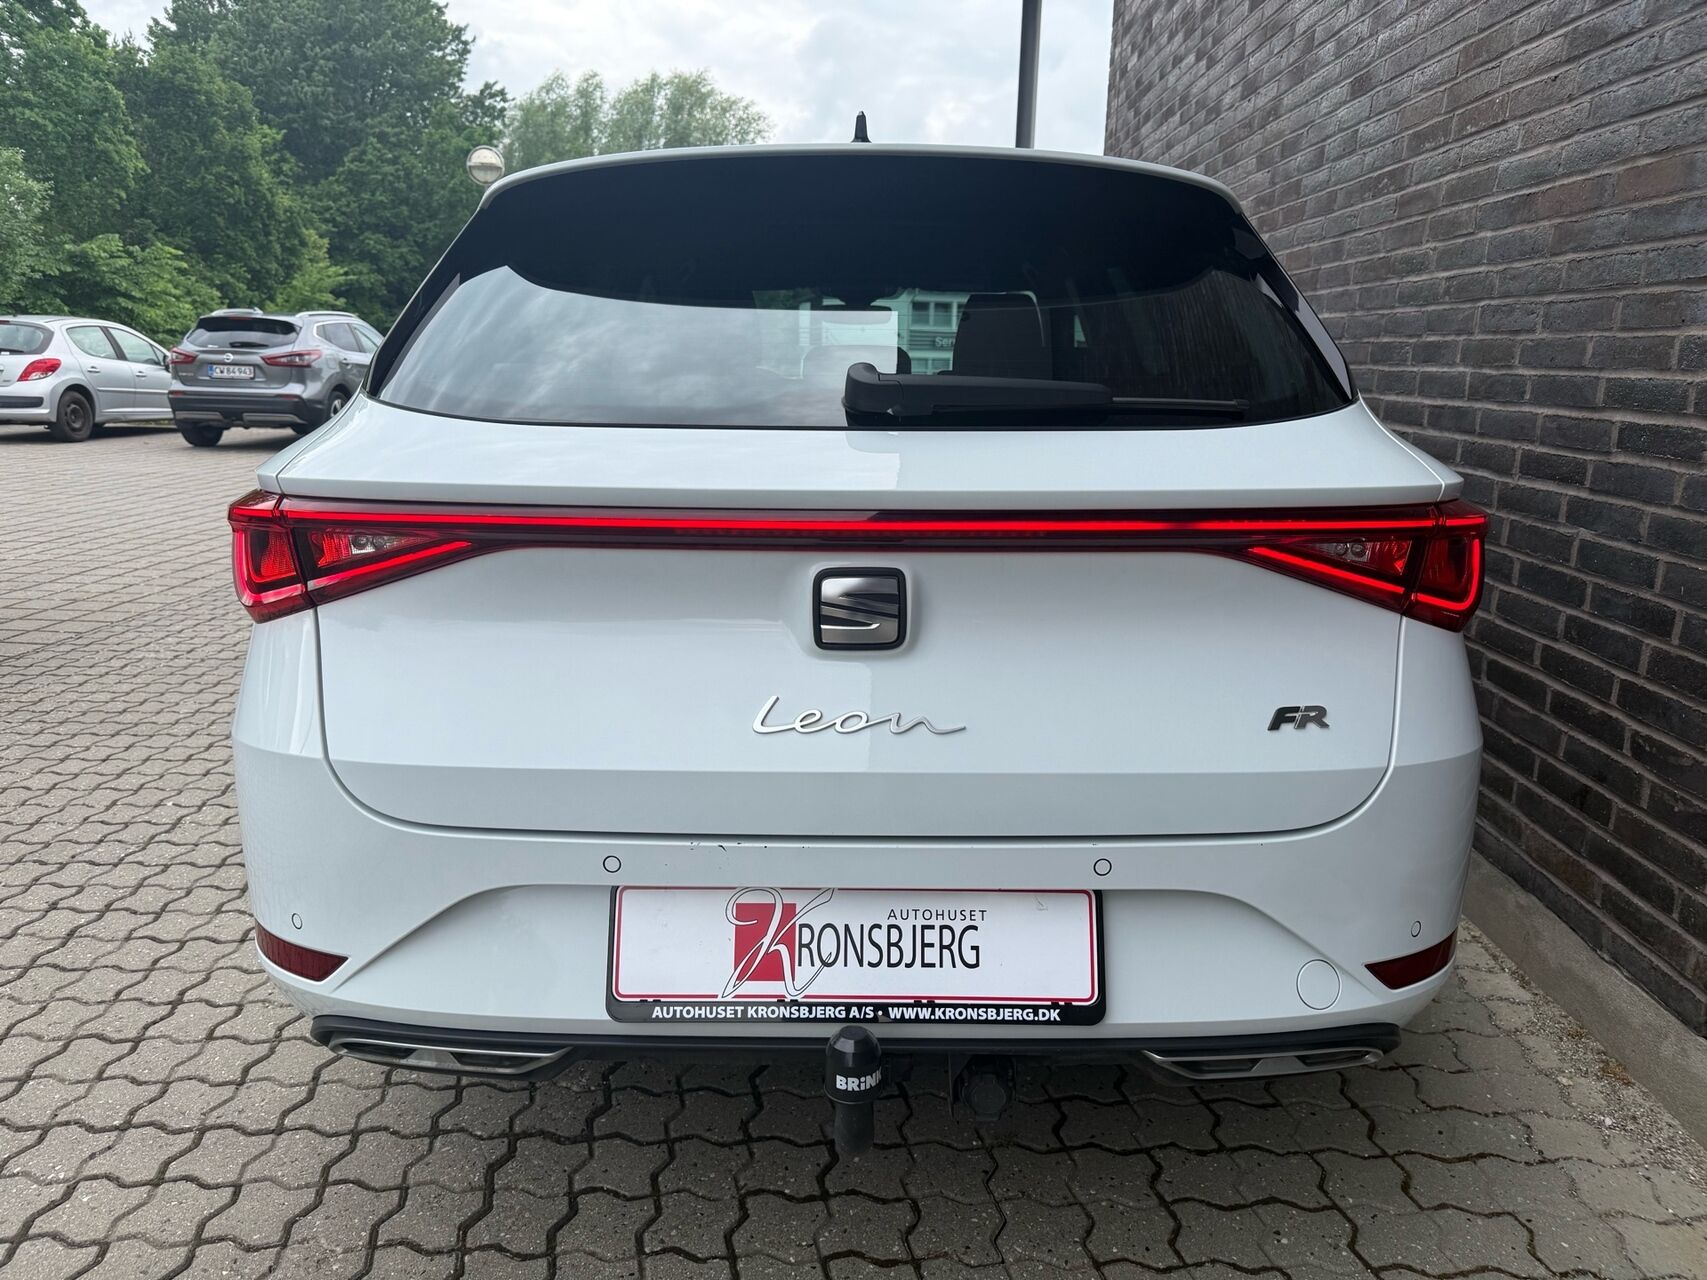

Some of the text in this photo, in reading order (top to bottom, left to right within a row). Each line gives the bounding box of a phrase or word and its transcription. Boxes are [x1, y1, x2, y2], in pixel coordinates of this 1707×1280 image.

[752, 695, 967, 735] Leon
[1267, 705, 1330, 731] FR
[887, 908, 987, 921] AUTOHUSET
[722, 887, 981, 998] KRONSBJERG
[652, 1006, 1061, 1021] AUTOHUSET KRONSBJERG A/S WWW.KRONSBJERG.DK
